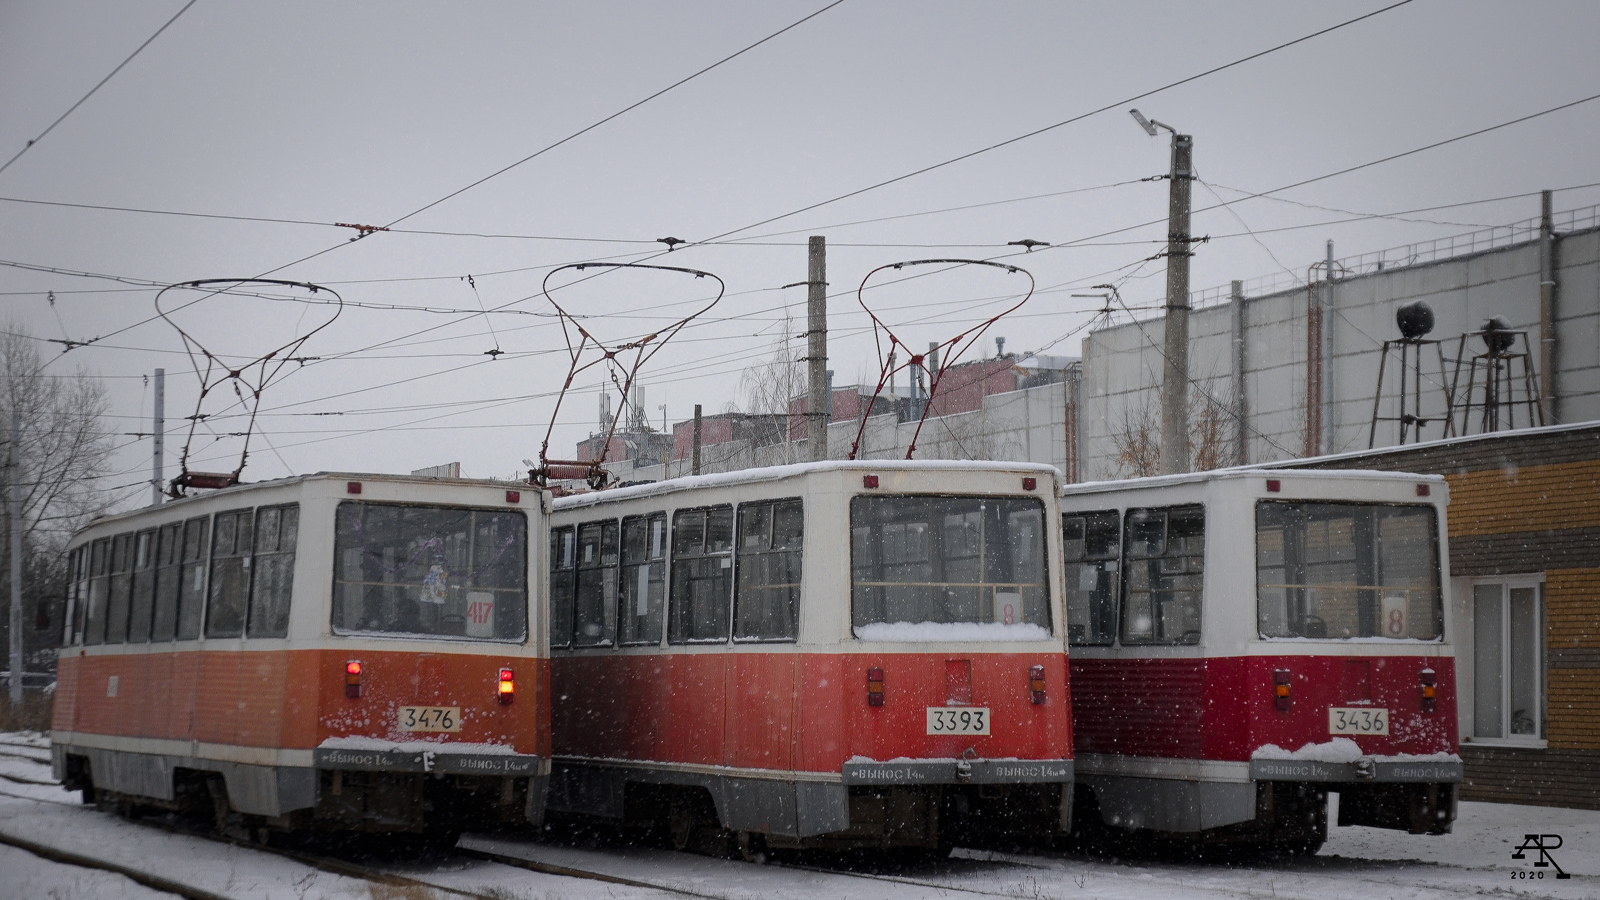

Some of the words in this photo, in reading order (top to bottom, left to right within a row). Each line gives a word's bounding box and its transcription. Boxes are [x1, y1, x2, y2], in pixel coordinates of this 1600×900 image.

[467, 602, 494, 624] 417
[1003, 603, 1015, 626] 8
[1389, 609, 1403, 635] 8
[933, 711, 984, 731] 3393
[1336, 711, 1384, 731] 3436
[329, 753, 373, 765] ВЫНОС
[460, 759, 501, 770] ВЫНОС
[859, 769, 903, 779] ВЫНОС
[996, 766, 1038, 777] ВЫНОС
[1267, 765, 1309, 775] ВЫНОС
[1393, 768, 1432, 778] ВЫНОС
